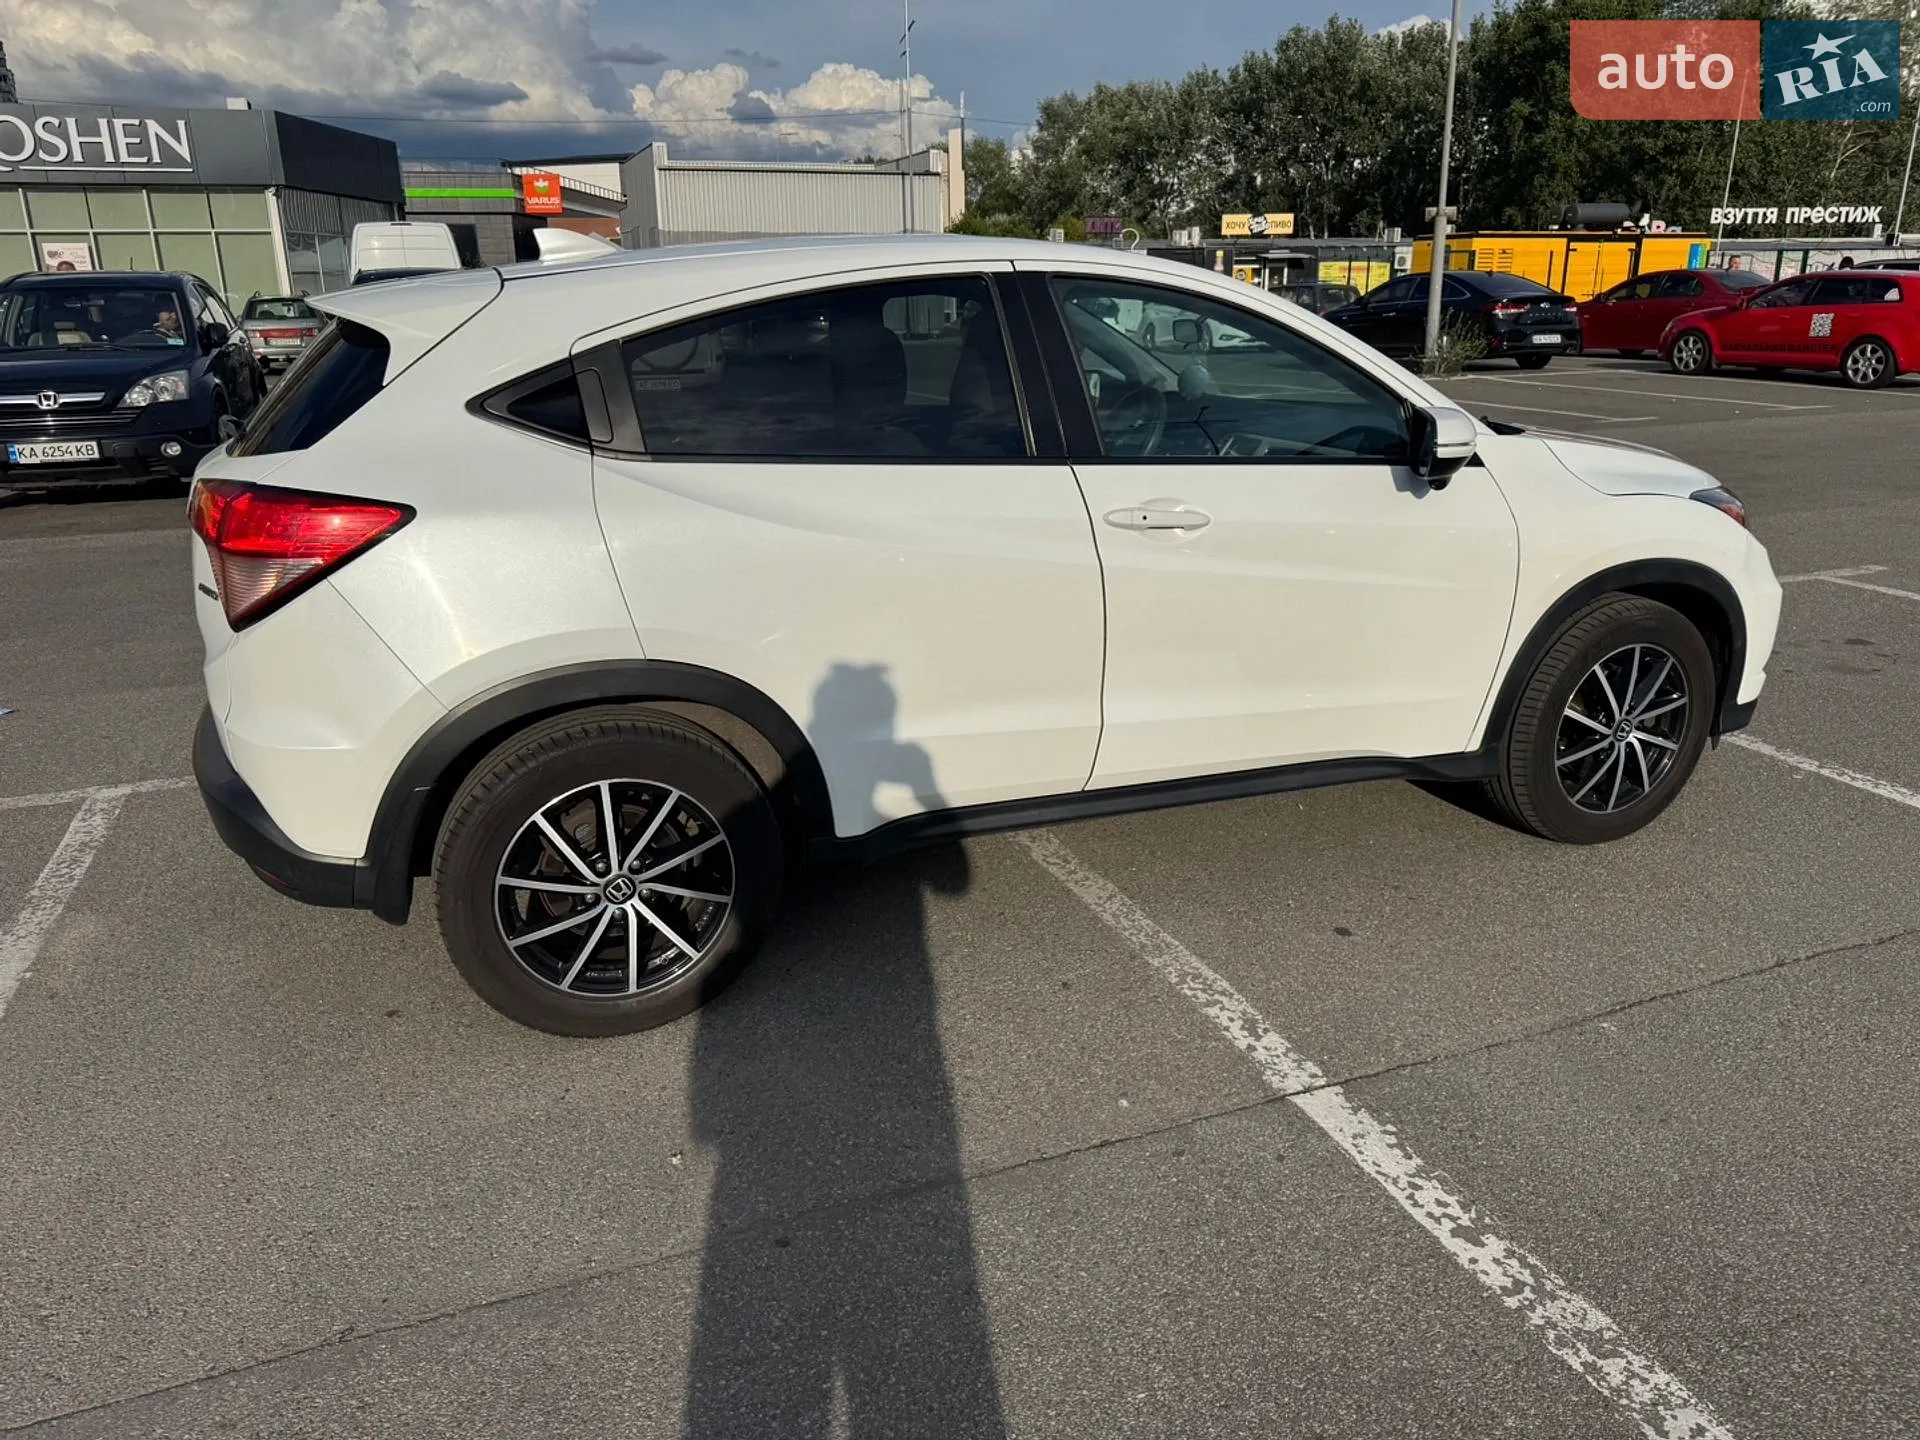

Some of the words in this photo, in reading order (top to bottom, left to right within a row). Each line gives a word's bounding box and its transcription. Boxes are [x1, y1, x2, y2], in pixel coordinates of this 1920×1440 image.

[0, 114, 193, 165] OSHEN
[526, 196, 560, 204] VARUS
[1709, 207, 1778, 225] ВЗУТТЯ
[1225, 220, 1247, 230] ХОЧУ
[1270, 219, 1292, 230] ПИВО
[17, 447, 39, 459] KA
[42, 445, 73, 458] 6254
[74, 444, 96, 457] KB
